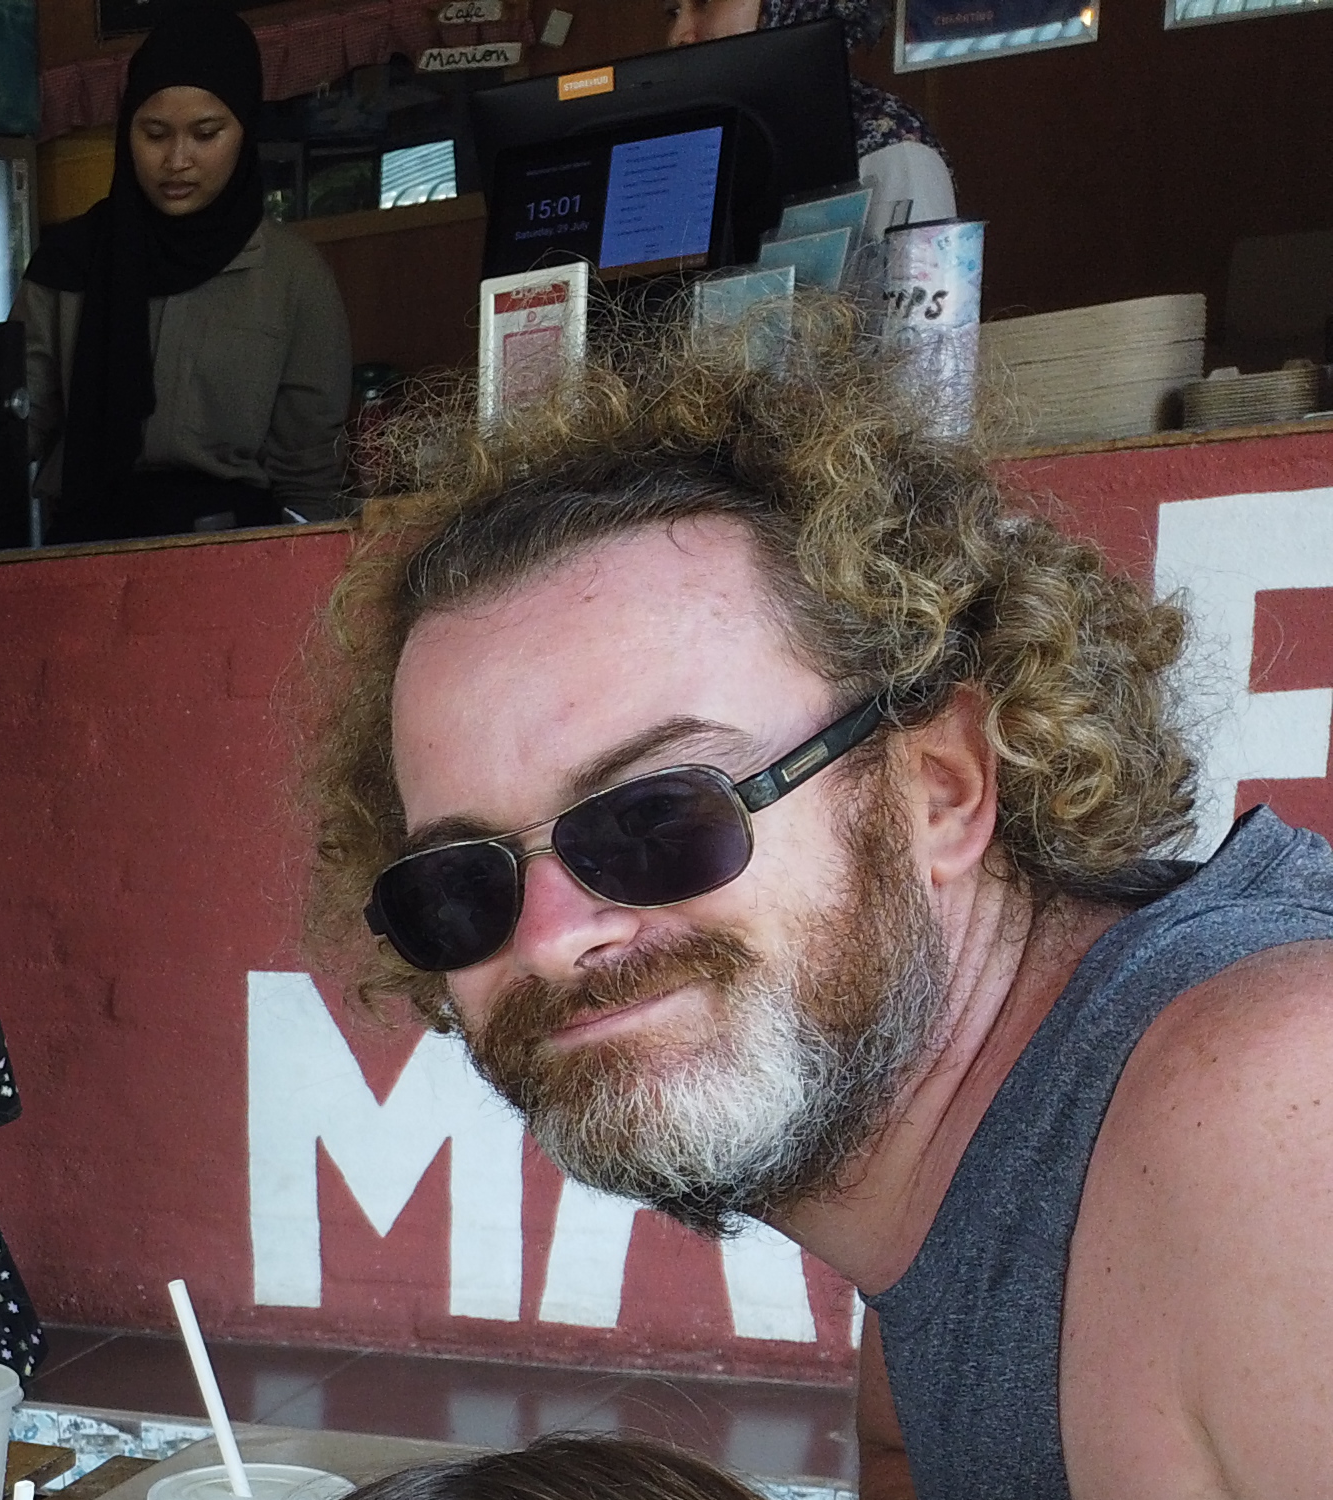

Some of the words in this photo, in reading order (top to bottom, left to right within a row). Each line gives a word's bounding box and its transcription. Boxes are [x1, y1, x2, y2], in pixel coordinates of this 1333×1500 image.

[443, 4, 486, 22] Cafe
[424, 49, 509, 68] Marion
[526, 194, 581, 220] 15:01
